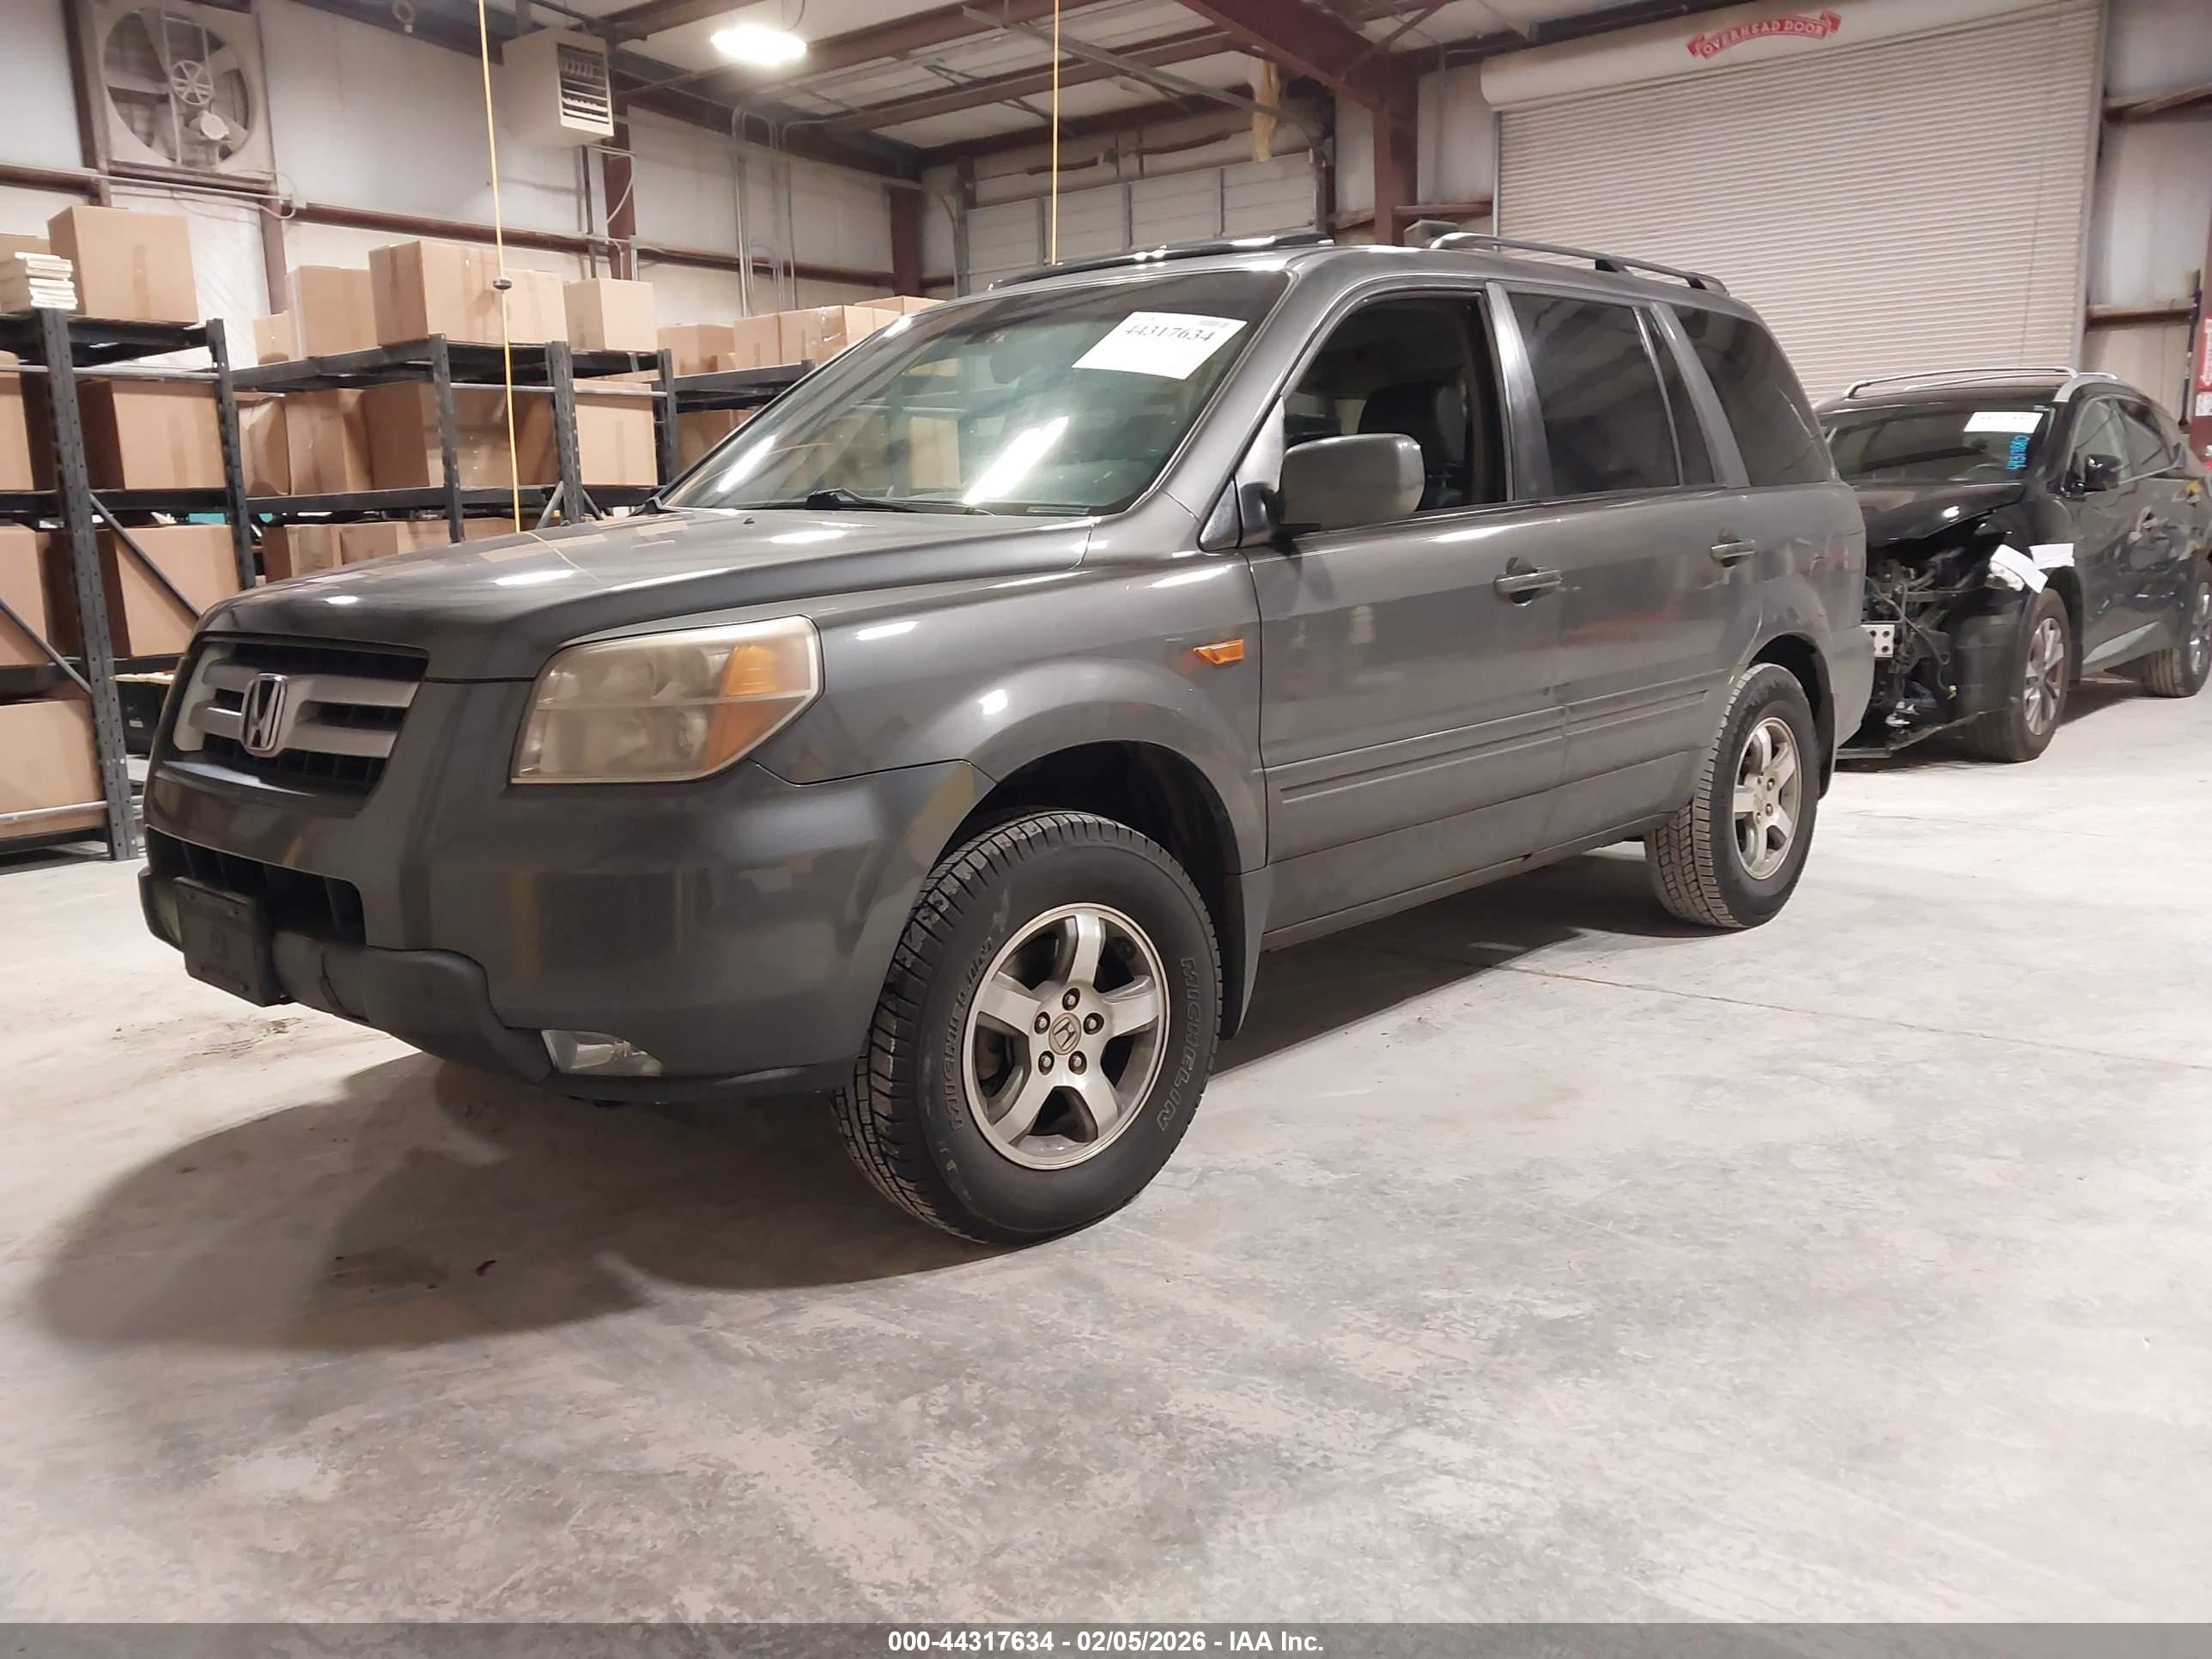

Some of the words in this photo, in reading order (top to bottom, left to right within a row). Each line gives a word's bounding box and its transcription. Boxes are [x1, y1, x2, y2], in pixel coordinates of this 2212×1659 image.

[1703, 20, 1781, 54] OVERHEAD
[1784, 20, 1824, 36] DOOR
[1124, 324, 1216, 342] 44317634
[944, 936, 992, 1130] MICHELIN
[1157, 957, 1201, 1132] MICHELIN
